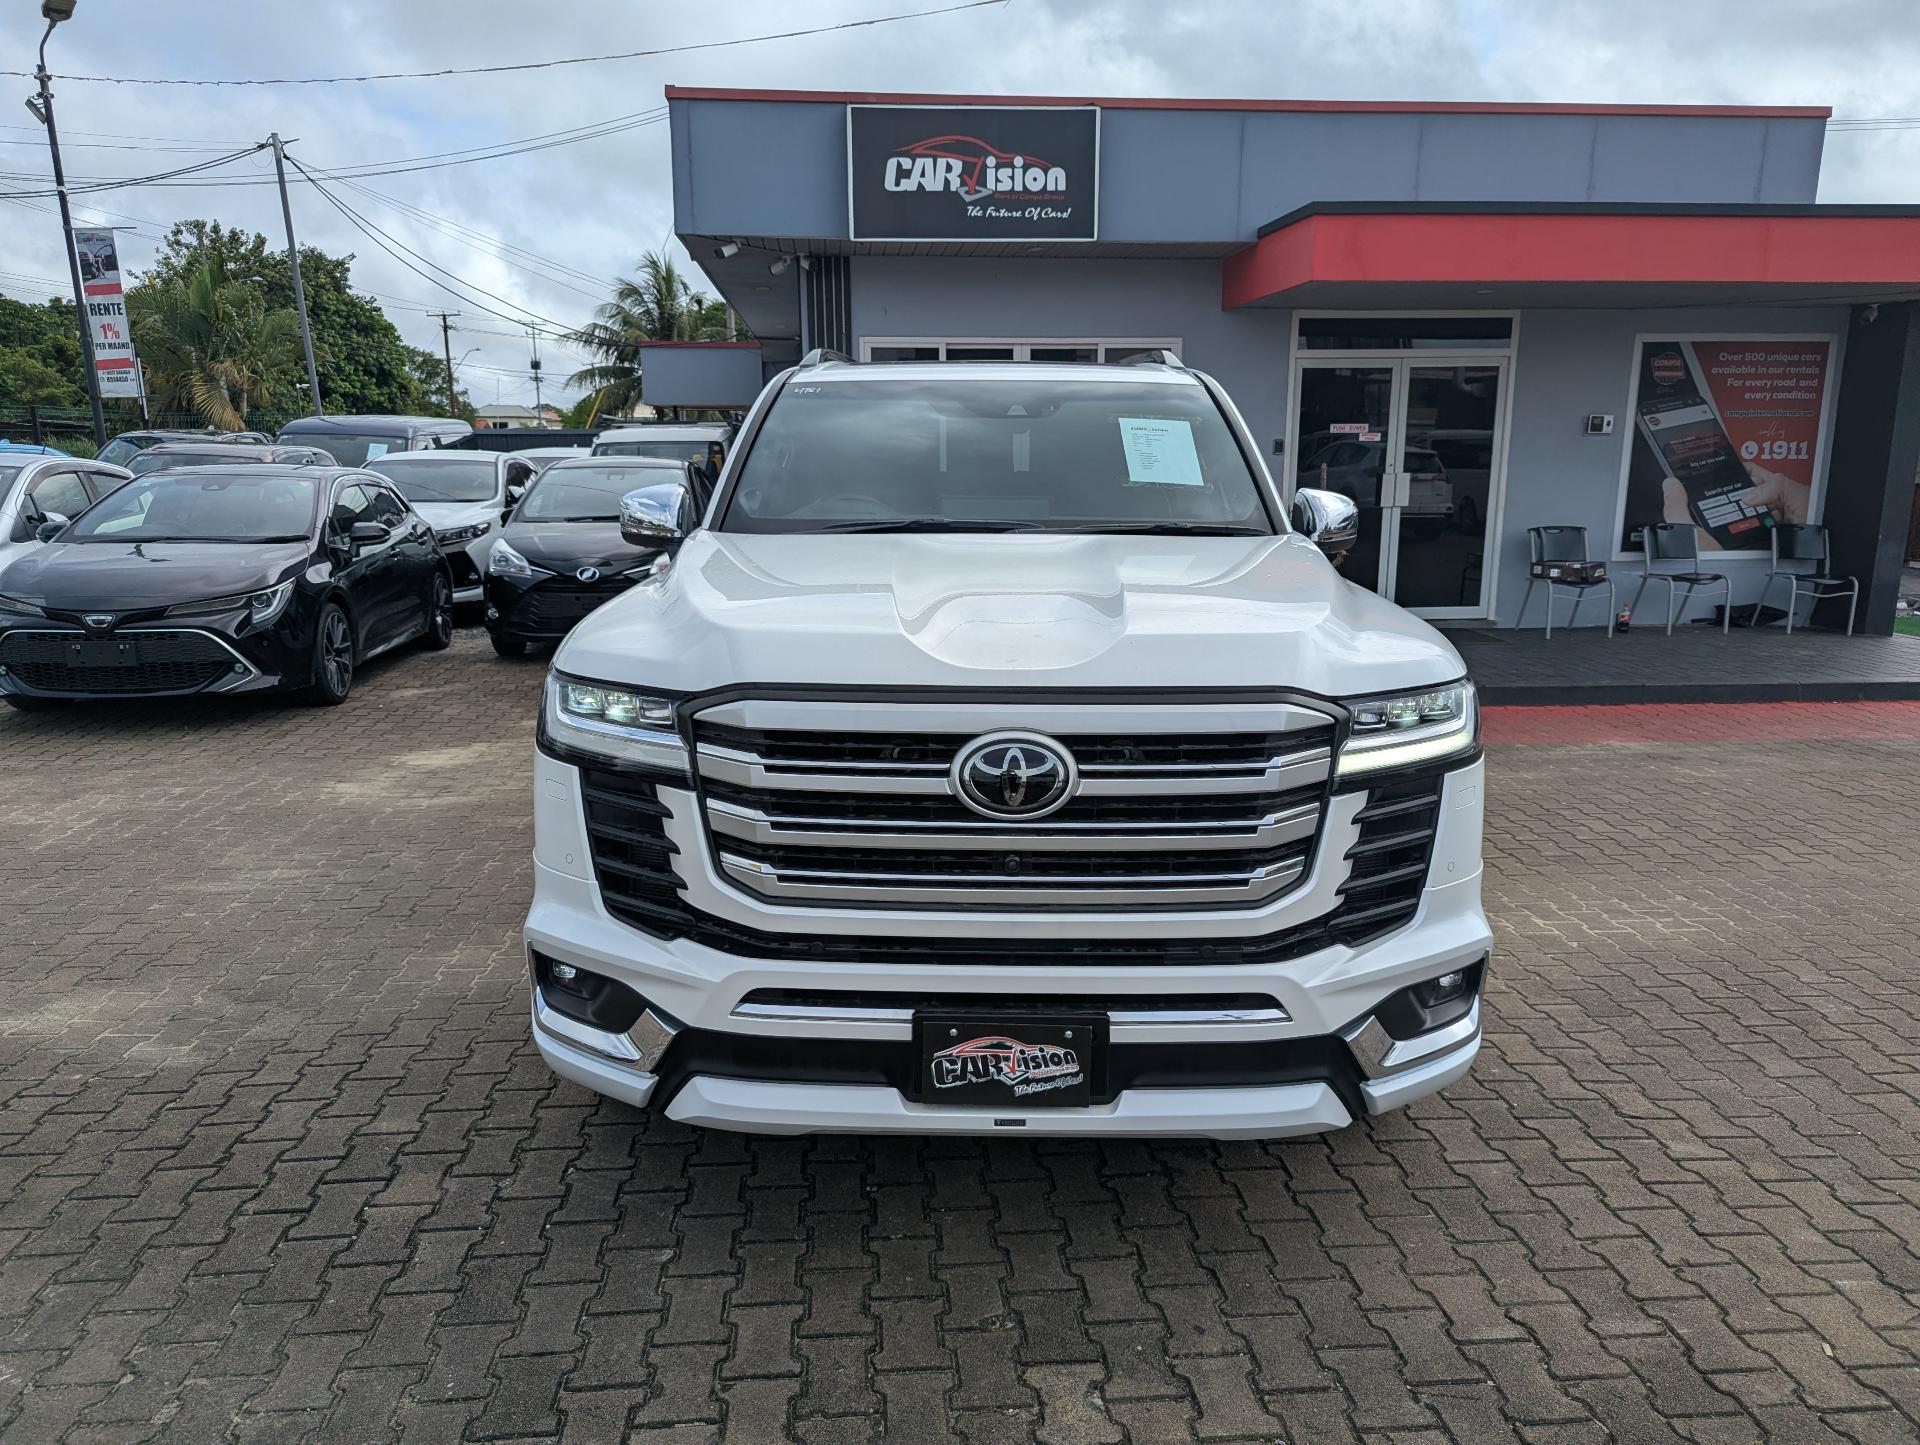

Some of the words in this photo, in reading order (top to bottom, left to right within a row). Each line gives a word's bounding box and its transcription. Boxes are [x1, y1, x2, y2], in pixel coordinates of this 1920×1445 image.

[967, 206, 983, 217] The
[985, 206, 1022, 218] Future
[1025, 207, 1041, 220] Of
[1041, 207, 1072, 218] Cars!
[89, 303, 124, 316] RENTE
[100, 322, 120, 339] 1%
[95, 342, 107, 350] PER
[107, 341, 130, 350] MAAND
[1719, 352, 1744, 361] Over
[1745, 352, 1765, 361] 500
[1766, 352, 1800, 363] unique
[1801, 353, 1821, 361] cars
[1711, 365, 1756, 374] available
[1757, 366, 1766, 374] in
[1786, 365, 1819, 374] rentals
[1727, 378, 1744, 387] For
[1744, 379, 1772, 389] every
[1773, 378, 1796, 387] road
[1799, 378, 1818, 387] and
[1744, 391, 1772, 401] every
[1772, 390, 1816, 400] condition
[1761, 440, 1808, 460] 1911
[1014, 1084, 1030, 1097] The
